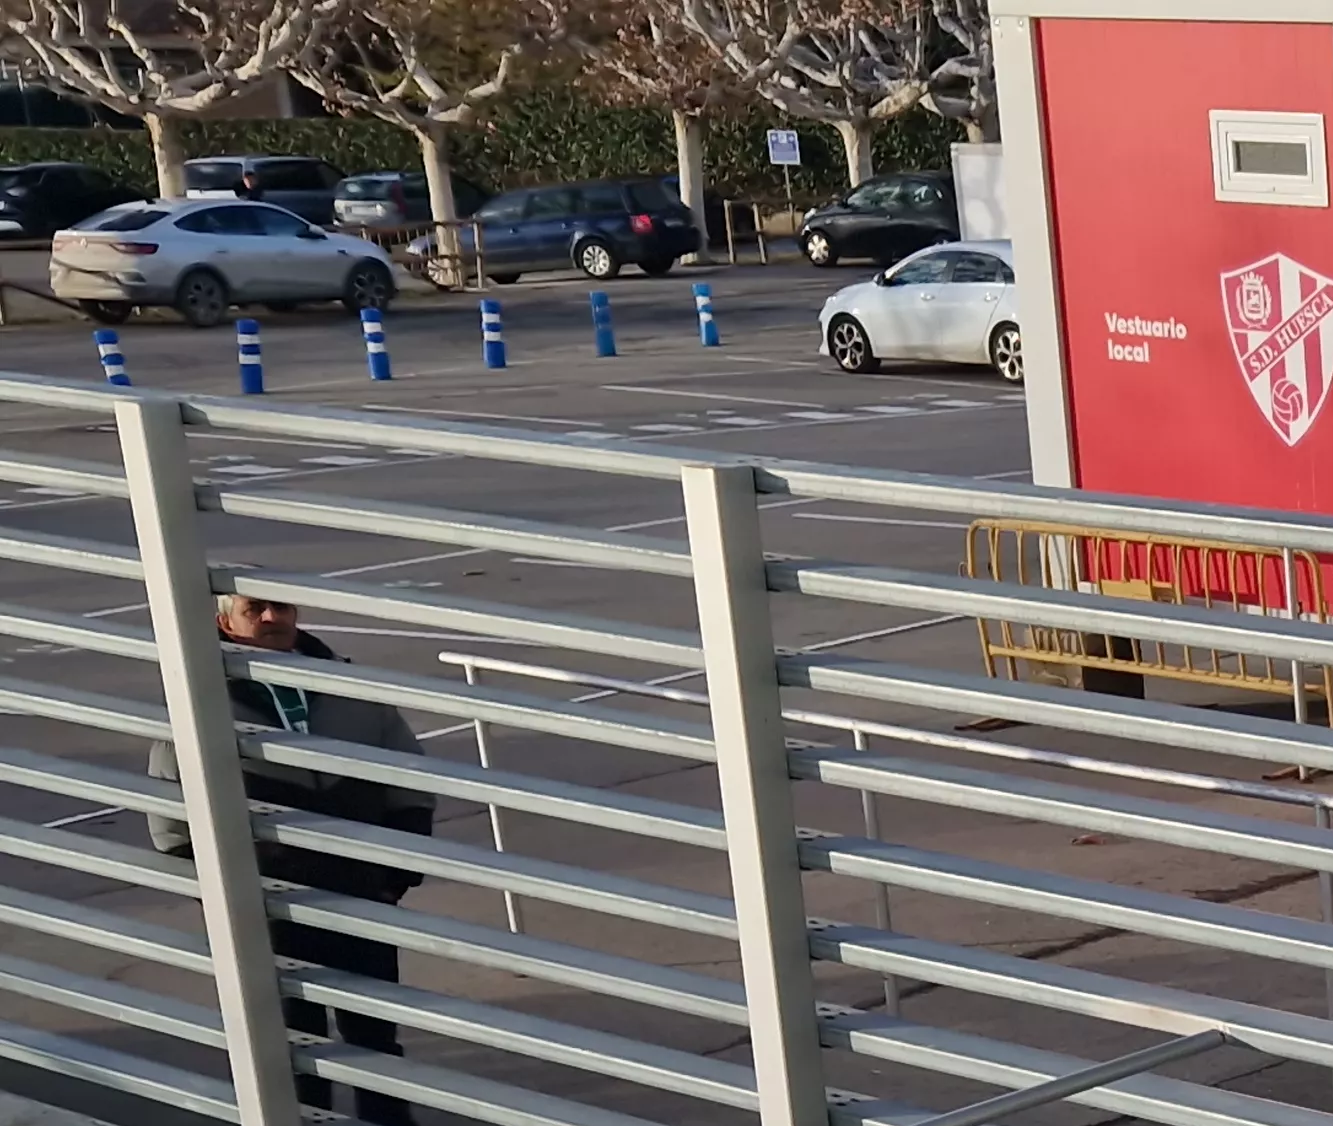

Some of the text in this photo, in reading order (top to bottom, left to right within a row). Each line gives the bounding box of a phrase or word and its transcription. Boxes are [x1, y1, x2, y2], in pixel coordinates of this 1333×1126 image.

[1104, 312, 1187, 339] Vestuario
[1250, 292, 1333, 373] S.D. HUESCA
[1108, 338, 1150, 362] local
